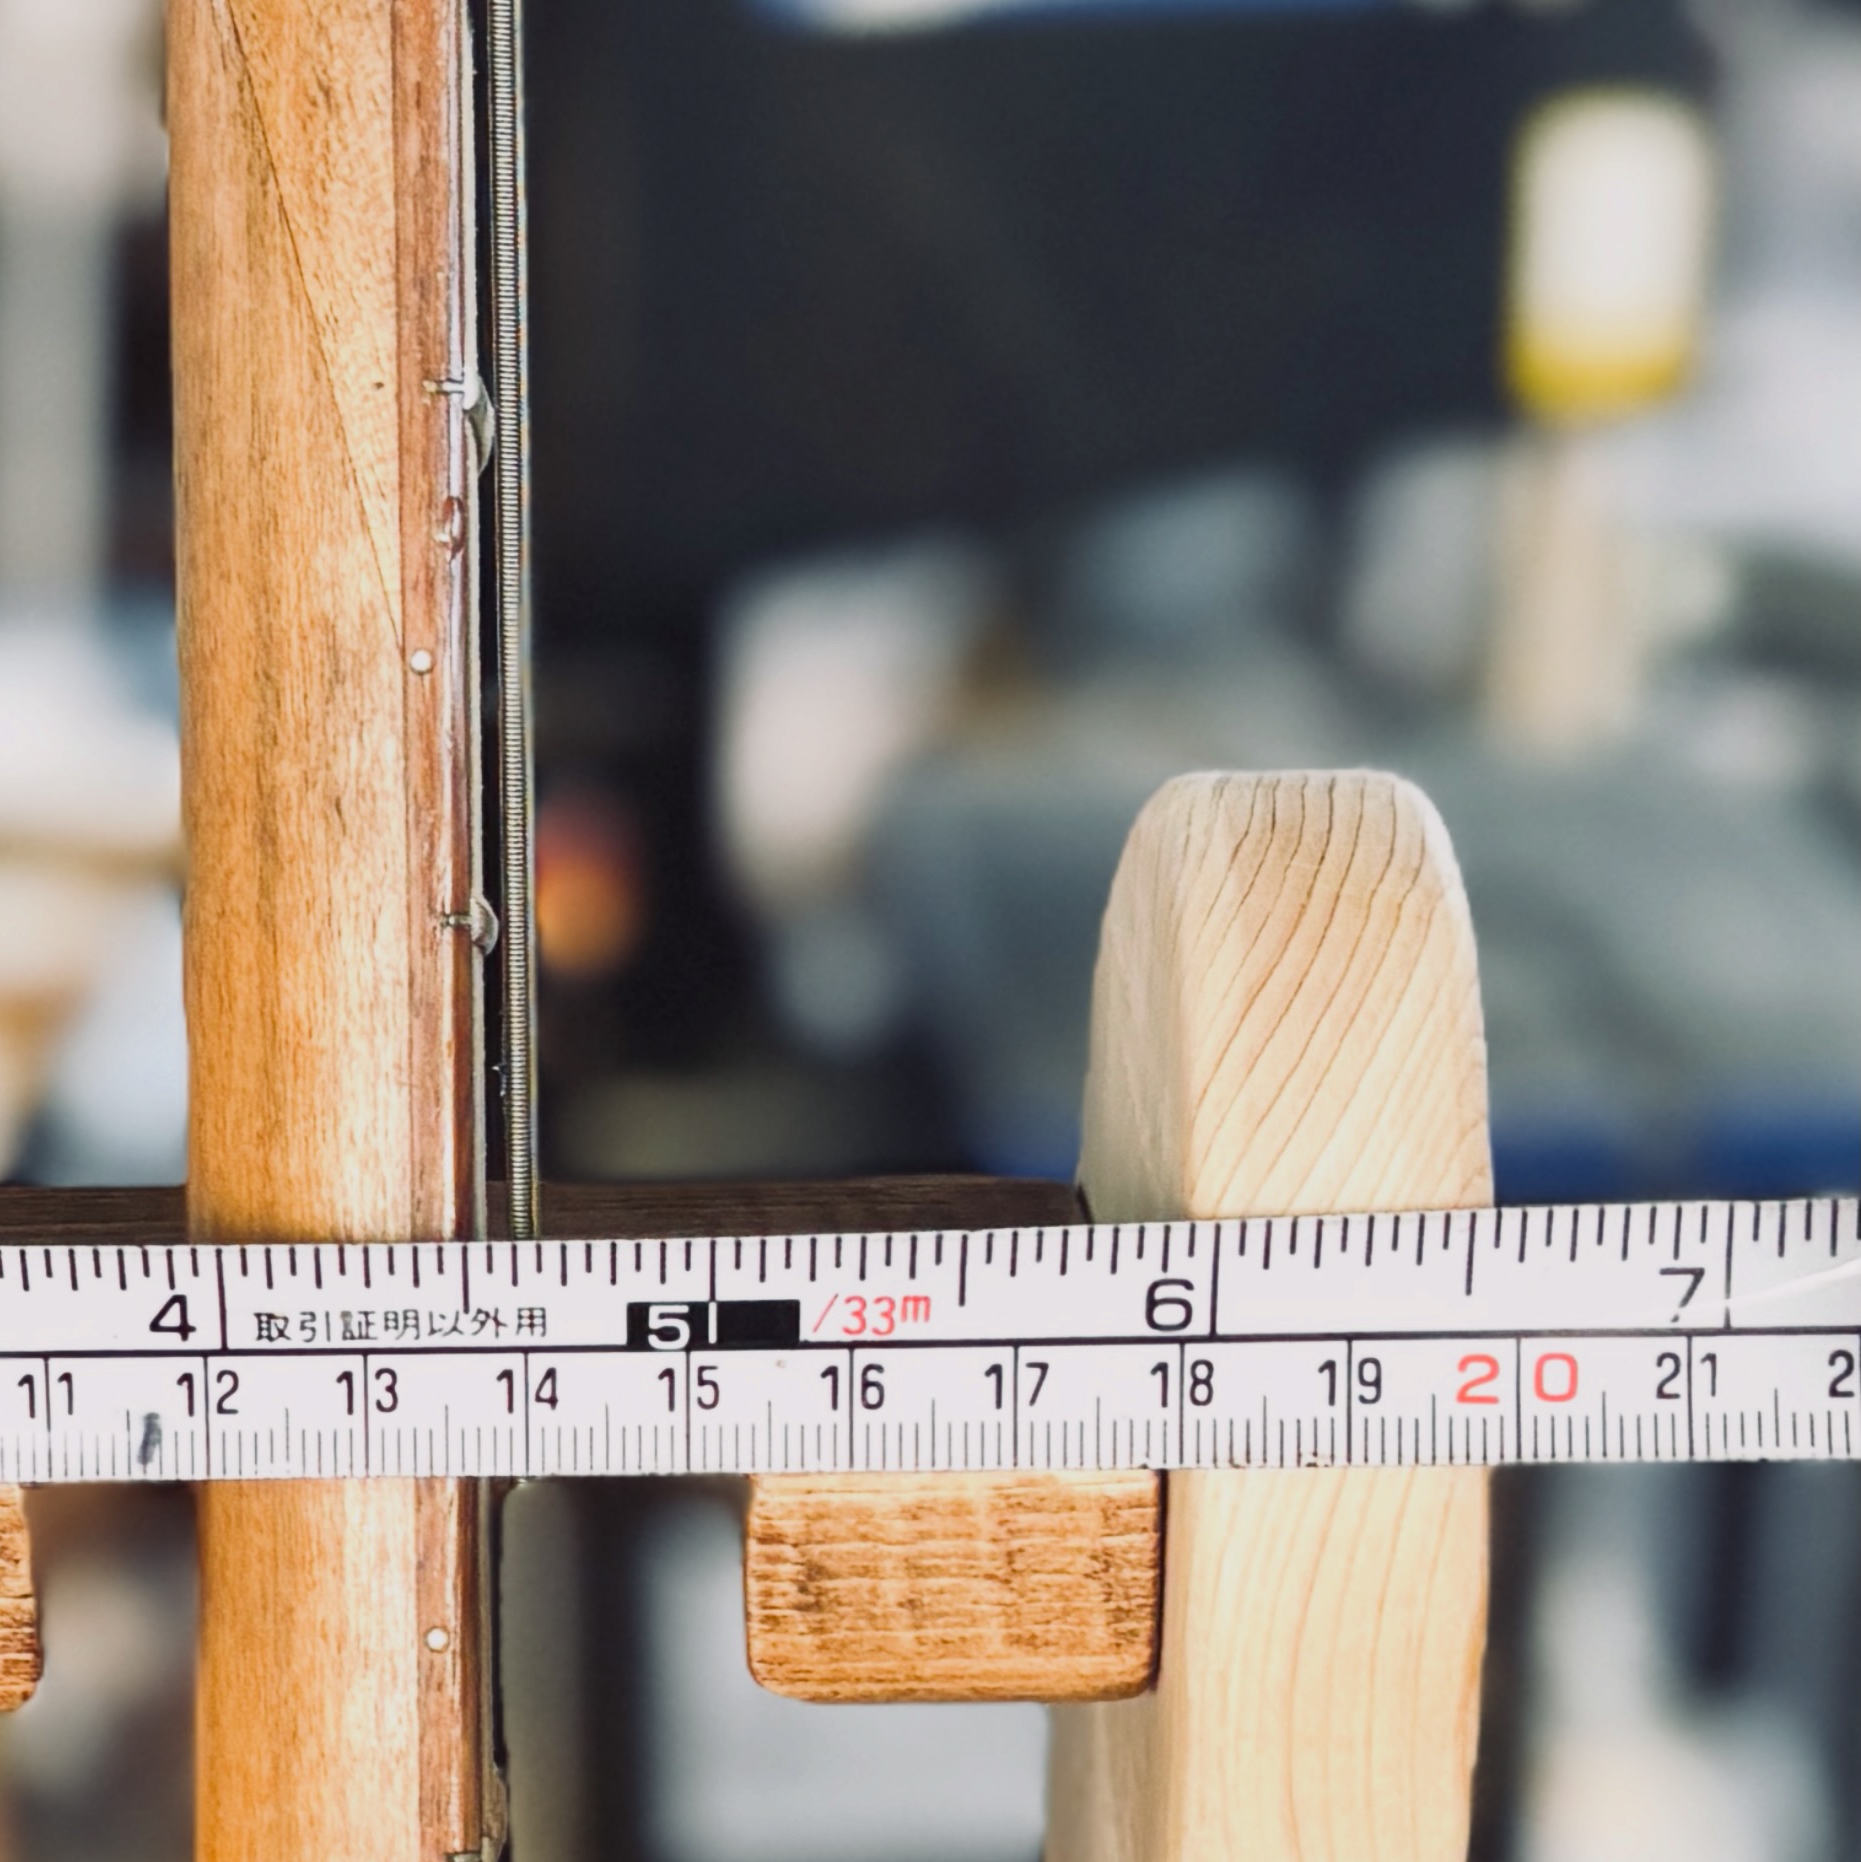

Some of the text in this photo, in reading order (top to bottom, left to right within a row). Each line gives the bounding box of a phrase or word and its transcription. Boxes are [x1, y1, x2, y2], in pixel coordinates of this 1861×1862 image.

[149, 1294, 197, 1342] 4
[1144, 1278, 1196, 1332] 6
[1659, 1266, 1706, 1324] 7
[254, 1306, 548, 1343] 取引証明以外用
[647, 1304, 691, 1350] 5
[17, 1372, 75, 1419] 11
[176, 1369, 240, 1417] 12
[336, 1368, 399, 1415] 13
[496, 1367, 559, 1413] 14
[657, 1365, 721, 1412] 15
[820, 1363, 885, 1411] 16
[984, 1361, 1050, 1410] 17
[1150, 1358, 1214, 1408] 18
[1317, 1356, 1383, 1406] 19
[1455, 1353, 1579, 1405] 20
[1655, 1352, 1718, 1400] 21
